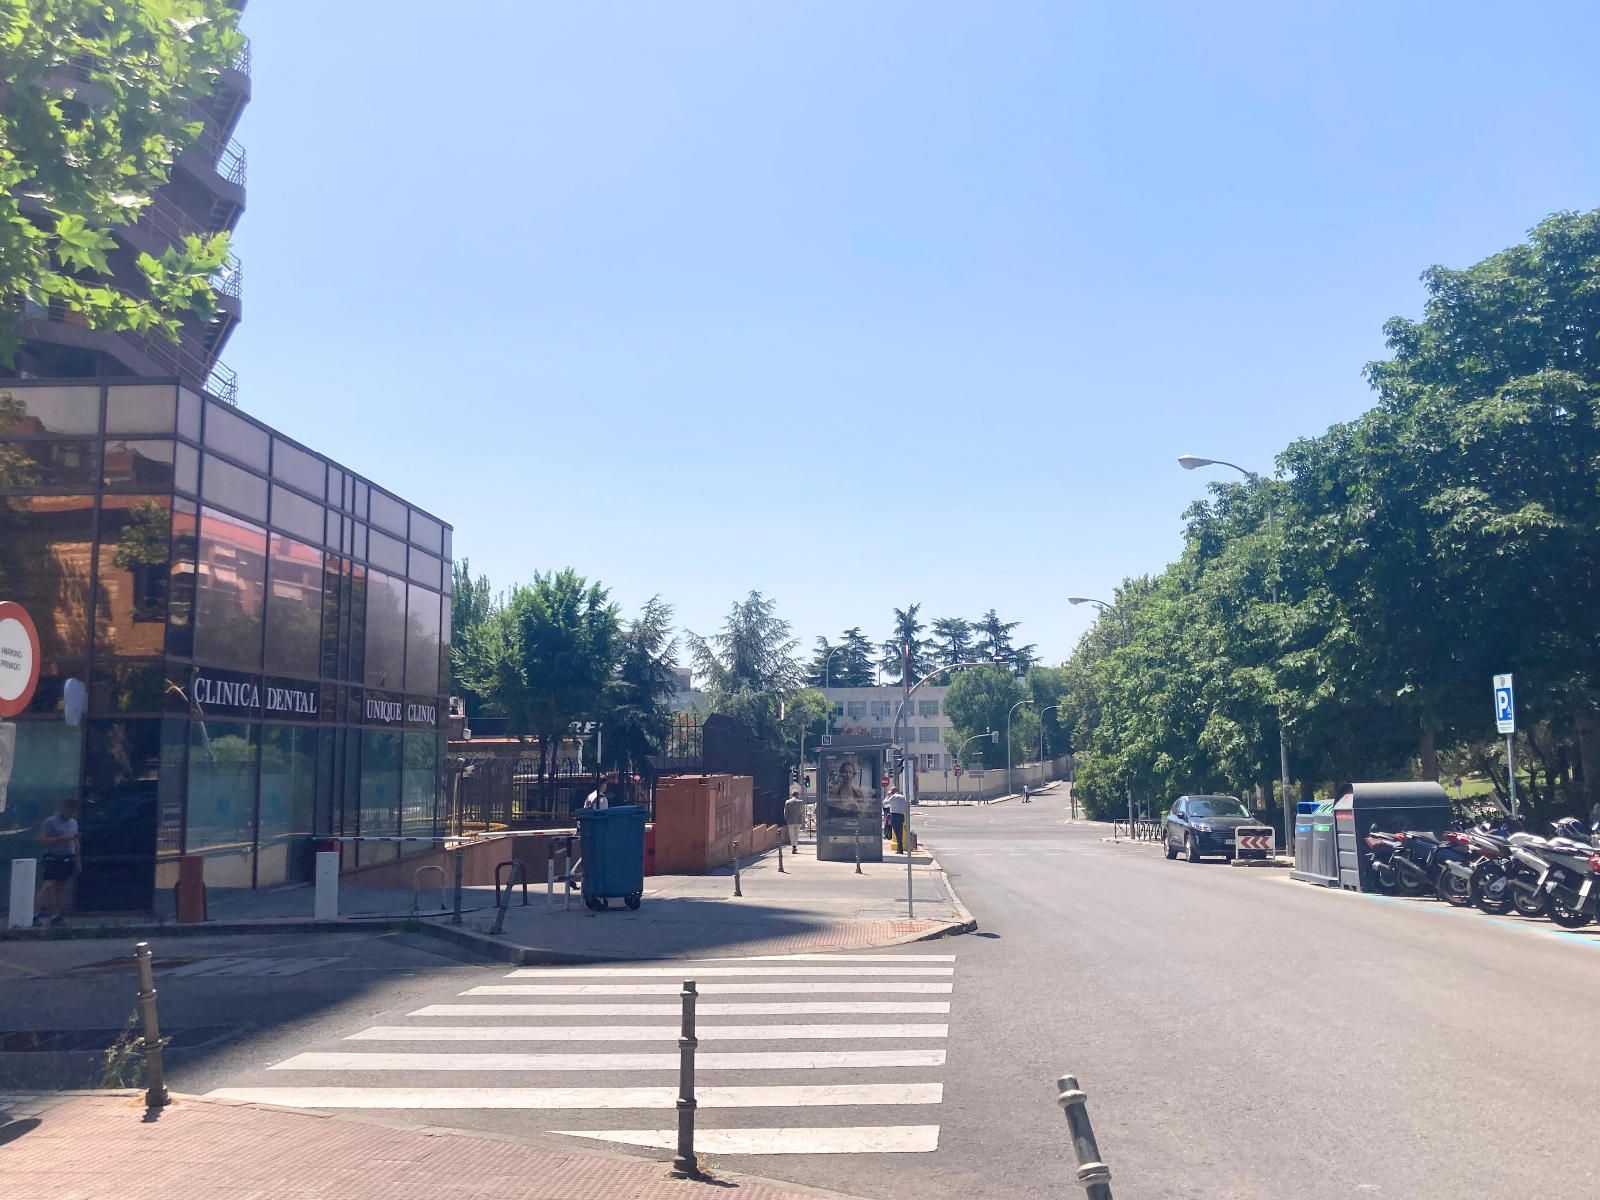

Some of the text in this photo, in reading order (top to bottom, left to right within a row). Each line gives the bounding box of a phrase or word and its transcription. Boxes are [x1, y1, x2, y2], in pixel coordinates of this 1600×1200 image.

[194, 677, 317, 714] CLINICA DENTAL
[1498, 691, 1508, 718] P
[367, 699, 436, 725] UNIQUE CLINIQ
